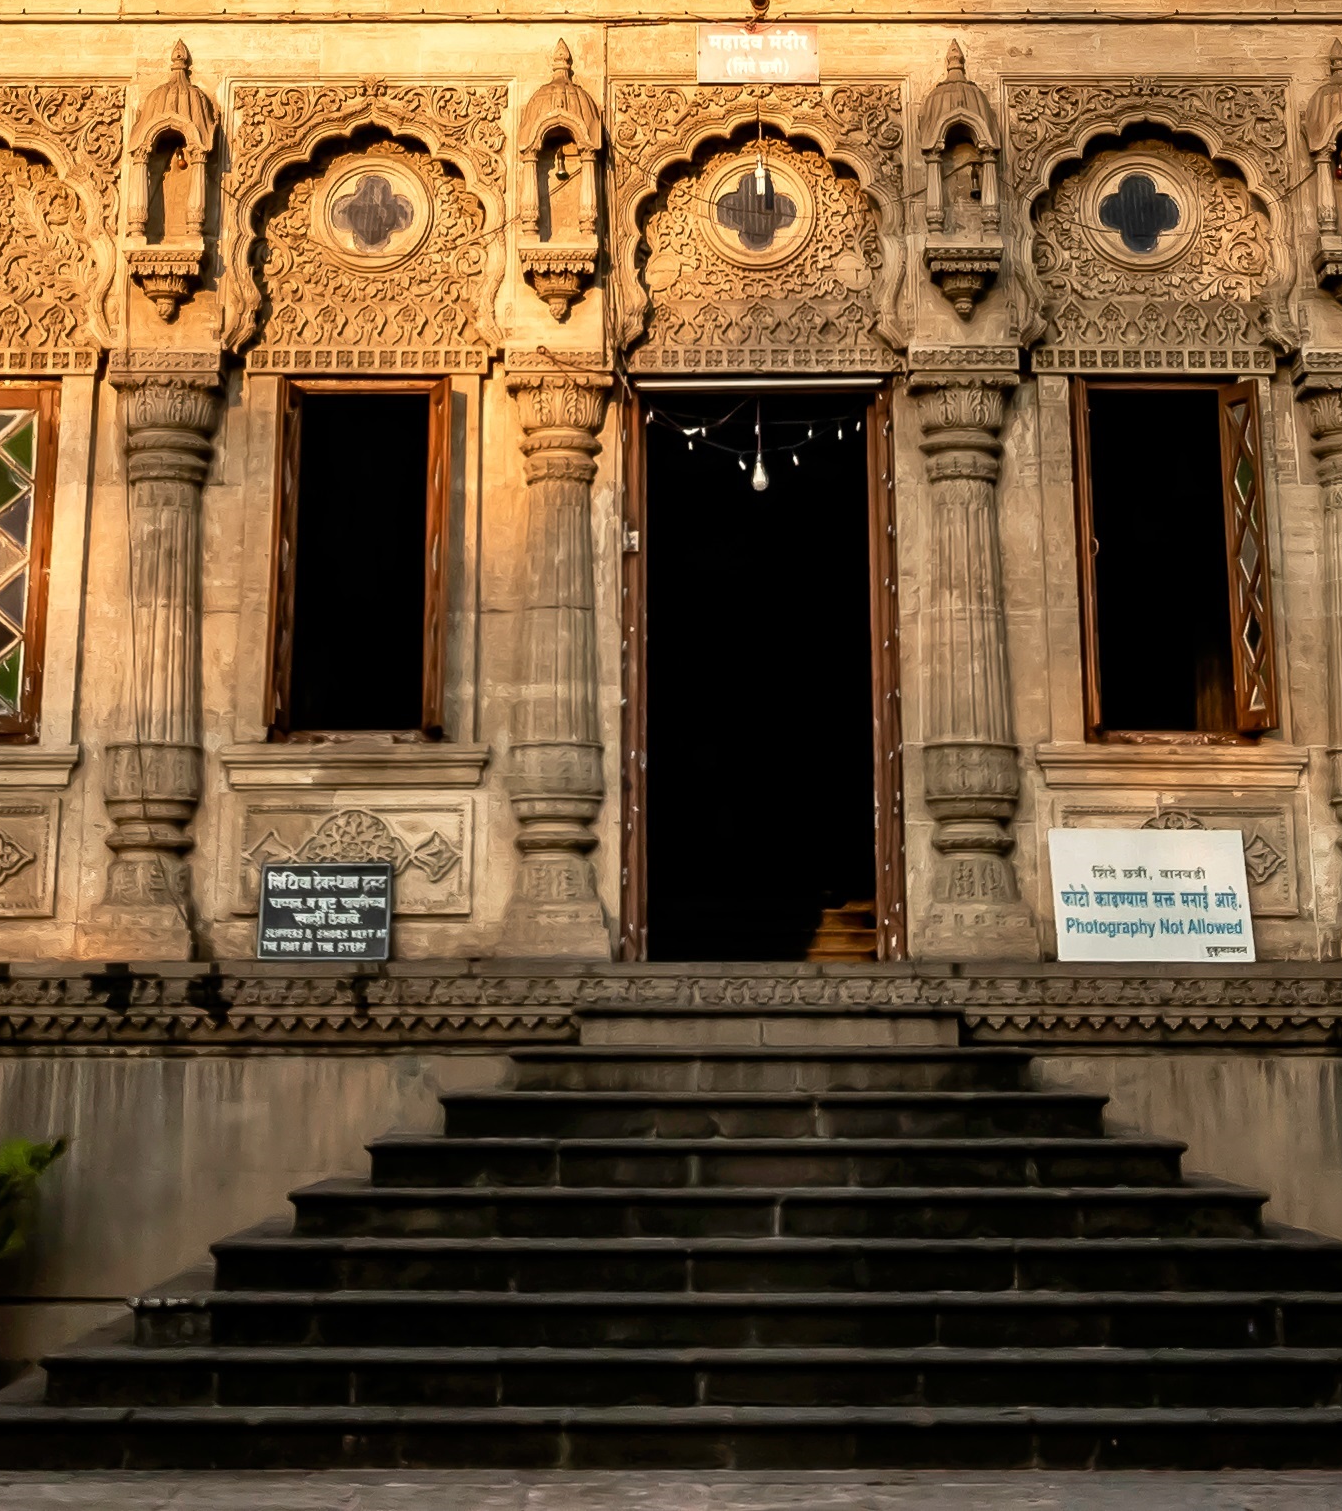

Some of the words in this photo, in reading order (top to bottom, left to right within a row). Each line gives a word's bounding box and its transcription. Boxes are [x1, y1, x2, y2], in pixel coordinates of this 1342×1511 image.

[708, 29, 764, 52] महादेव
[1066, 917, 1156, 938] Photography
[1160, 918, 1184, 934] Not
[1187, 918, 1243, 935] Allowed
